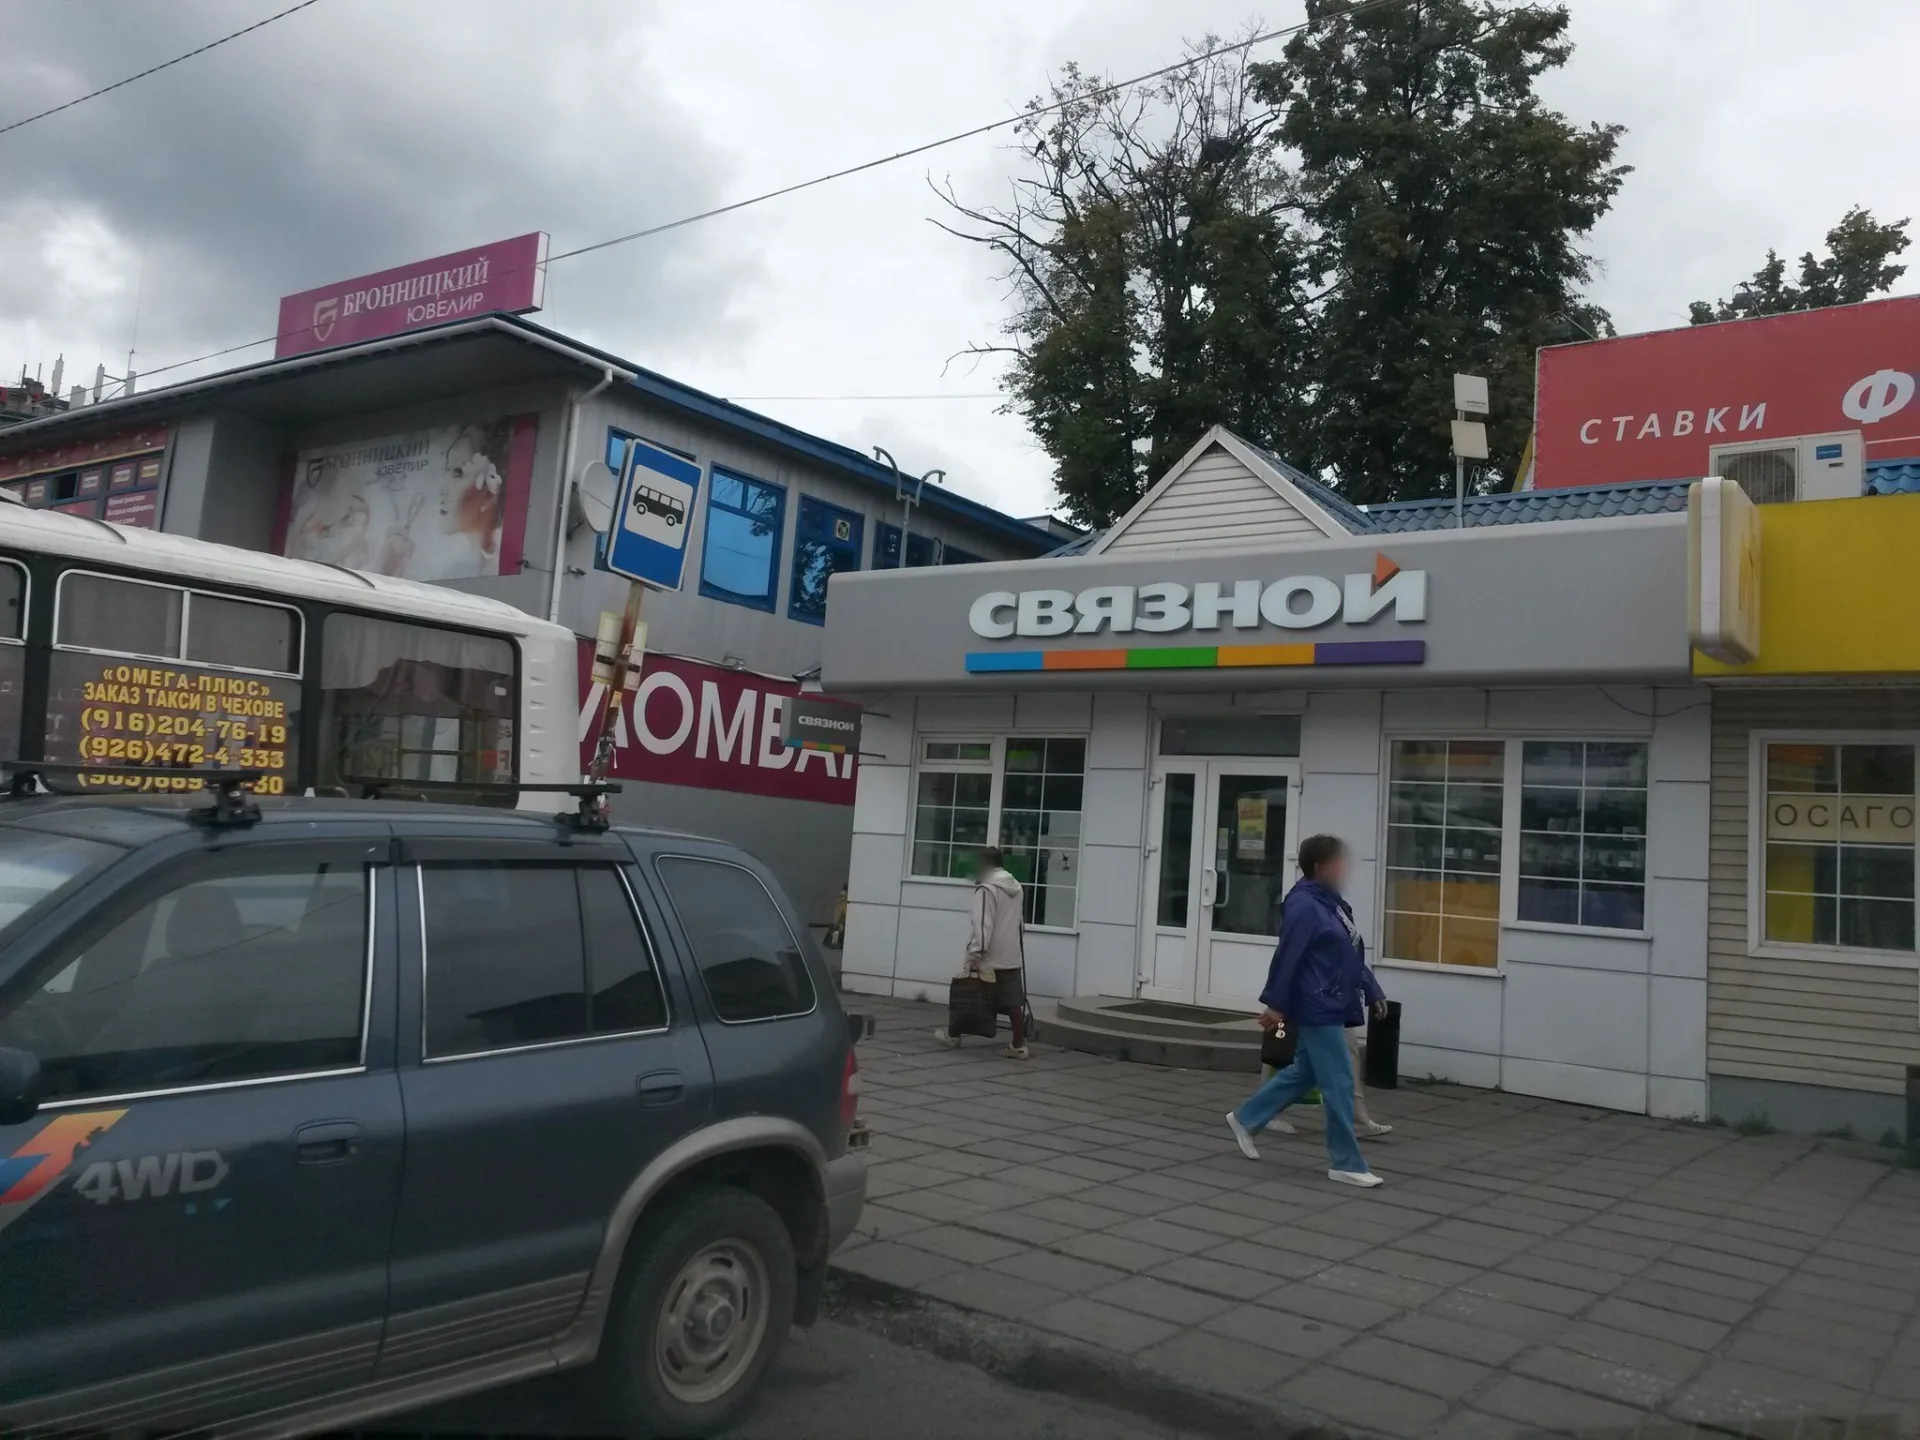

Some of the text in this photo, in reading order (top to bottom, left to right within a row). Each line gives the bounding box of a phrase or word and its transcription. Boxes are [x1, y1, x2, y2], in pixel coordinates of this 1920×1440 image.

[343, 255, 490, 316] БРОННИЦКИЙ
[406, 292, 484, 324] ЮВЕЛИР
[1580, 402, 1767, 445] СТАВКИ
[375, 459, 428, 477] ЮВЕЛИР
[968, 553, 1427, 639] СВЯЗНОЙ
[103, 666, 270, 697] «ОМЕГА-ПЛЮС»
[84, 682, 284, 718] ЗАКАЗ ТАКСИ В ЧЕХОВЕ
[81, 707, 286, 743] (916)204-76-19
[579, 671, 854, 779] ЛОМБ
[1774, 804, 1914, 829] ОСАГО
[73, 1150, 229, 1205] 4WD
